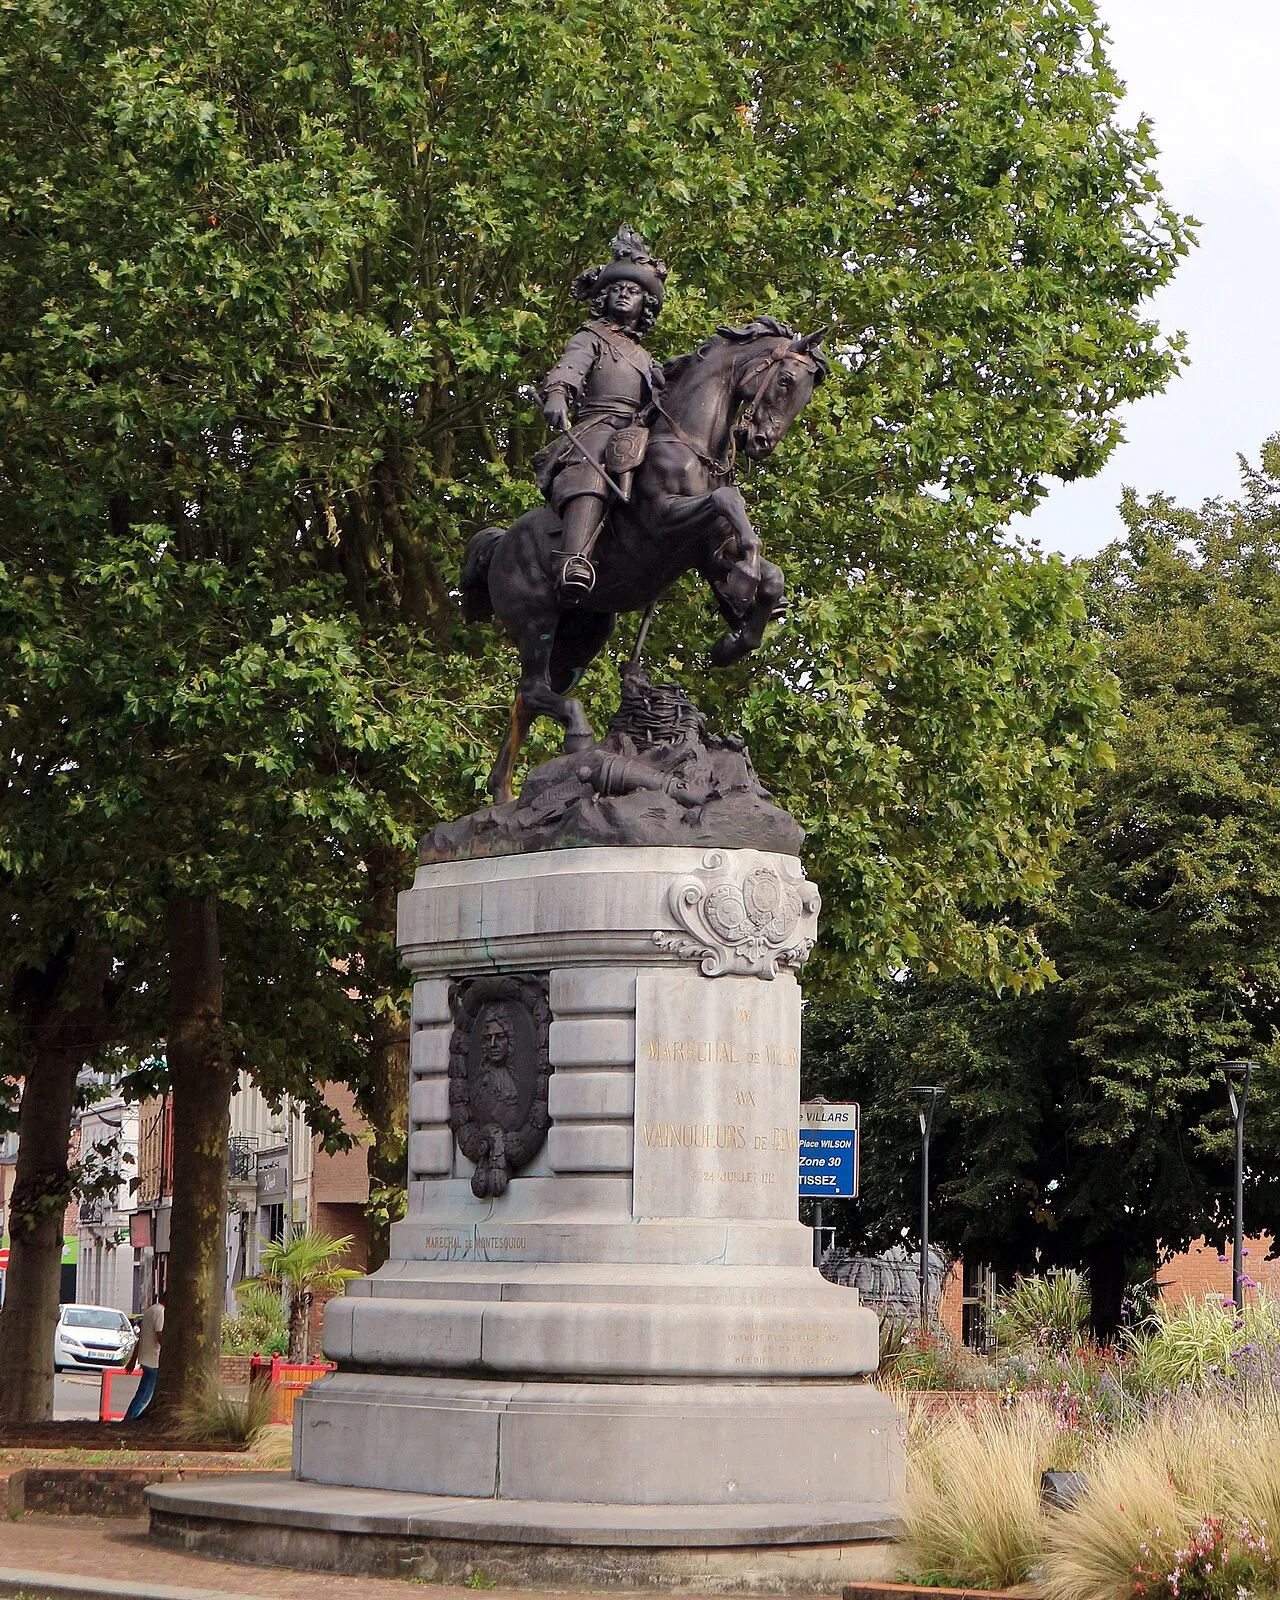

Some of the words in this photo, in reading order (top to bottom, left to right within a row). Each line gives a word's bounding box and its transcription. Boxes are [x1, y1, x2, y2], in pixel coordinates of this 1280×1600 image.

[747, 1052, 760, 1064] DE
[806, 1112, 849, 1122] VILLARS
[643, 1124, 746, 1149] VAINQUEURS
[754, 1136, 767, 1150] DE
[799, 1140, 818, 1148] Place
[821, 1140, 851, 1148] WILSON
[799, 1157, 825, 1166] Zone
[828, 1157, 841, 1166] 30
[720, 1171, 758, 1183] JUILLET
[799, 1175, 837, 1185] TISSEZ
[475, 1236, 526, 1250] MONTESQUIOU
